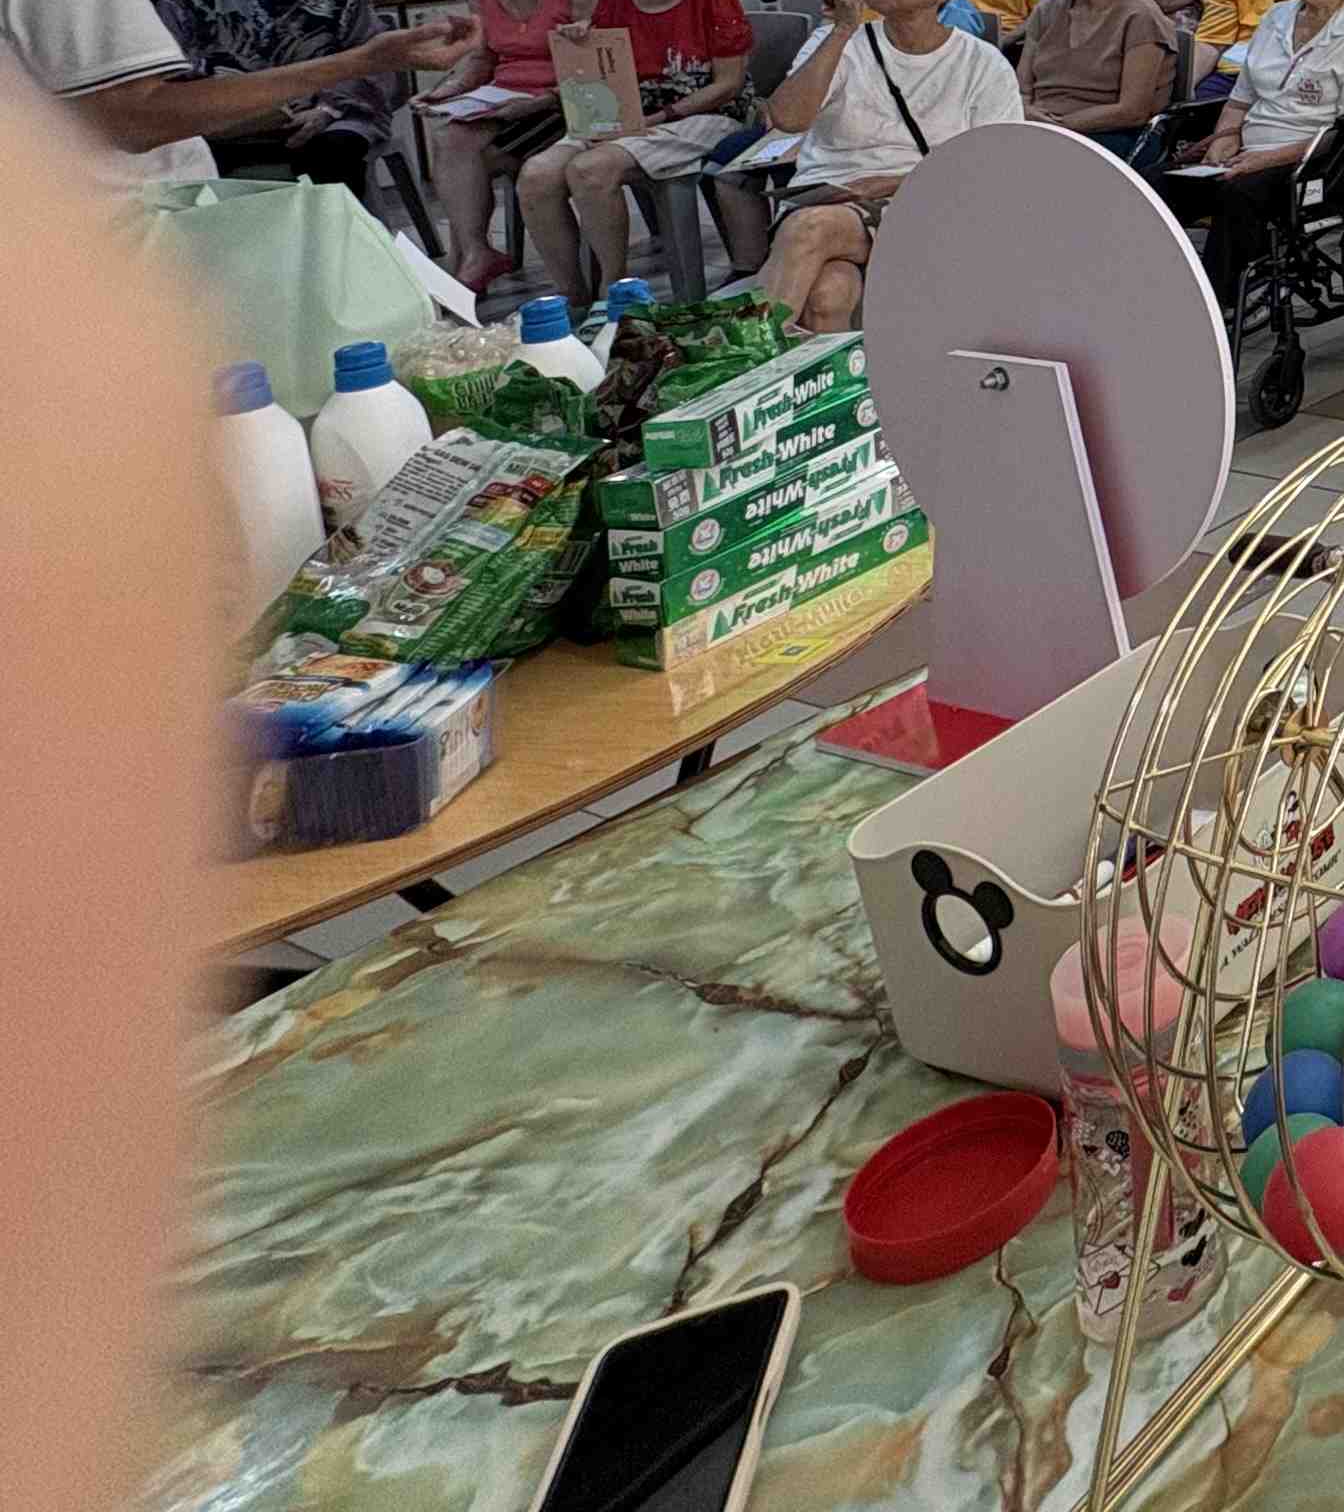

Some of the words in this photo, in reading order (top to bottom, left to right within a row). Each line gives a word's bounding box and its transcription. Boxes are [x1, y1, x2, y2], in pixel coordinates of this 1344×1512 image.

[752, 396, 793, 431] Fresh
[794, 370, 836, 409] White
[720, 444, 775, 485] Fresh
[776, 423, 836, 461] White
[744, 481, 806, 520] White
[748, 531, 814, 570] White
[727, 580, 791, 629] Fresh
[797, 552, 861, 592] White
